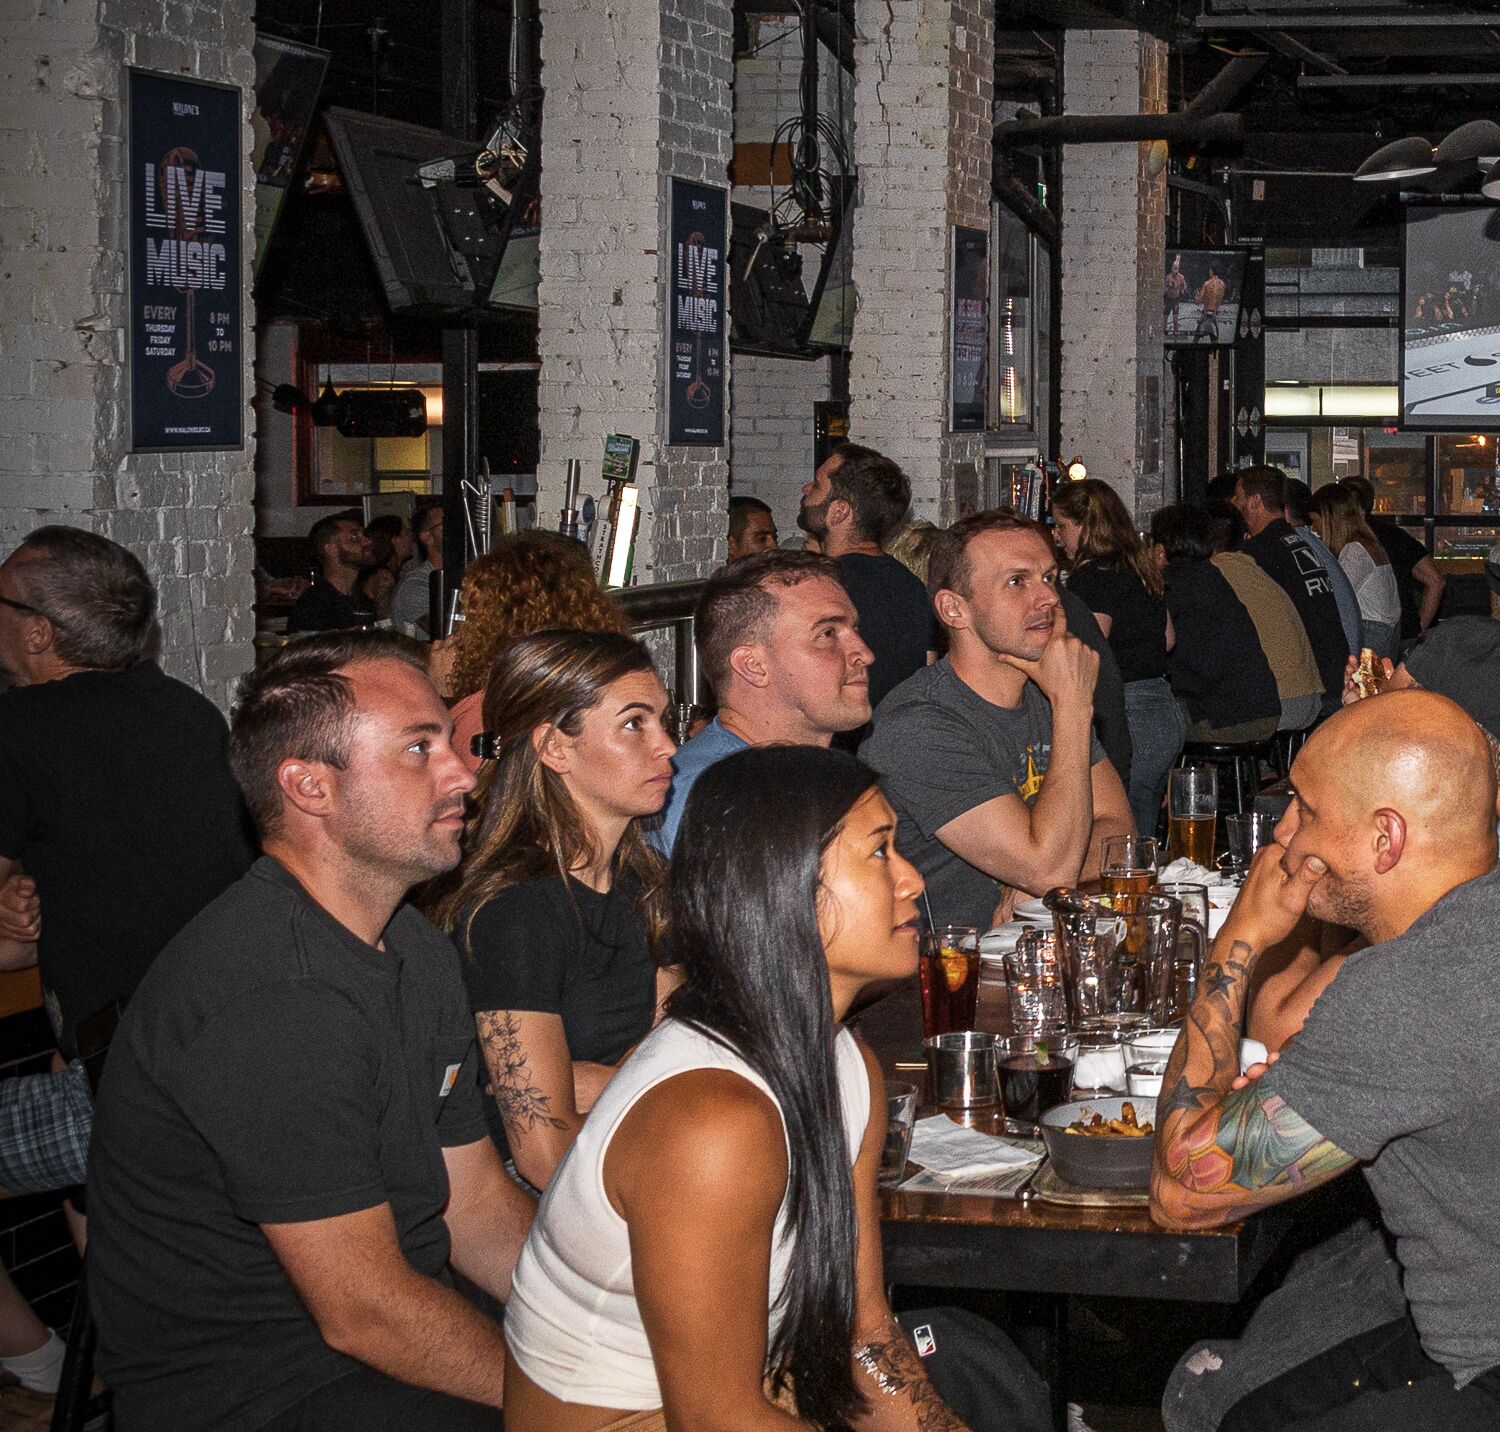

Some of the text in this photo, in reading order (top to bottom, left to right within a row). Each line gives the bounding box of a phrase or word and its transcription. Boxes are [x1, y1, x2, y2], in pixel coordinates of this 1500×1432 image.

[145, 163, 226, 234] LIVE
[146, 237, 226, 290] MUSIC
[678, 243, 719, 293] LIVE
[143, 305, 177, 321] EVERY
[209, 312, 230, 325] 8 PM
[677, 295, 718, 333] MUSIC
[145, 323, 176, 333] THURSDAY
[216, 328, 225, 337] TO
[150, 335, 171, 345] FRIDAY
[208, 340, 232, 353] 10 PM
[145, 347, 176, 356] SATURDAY
